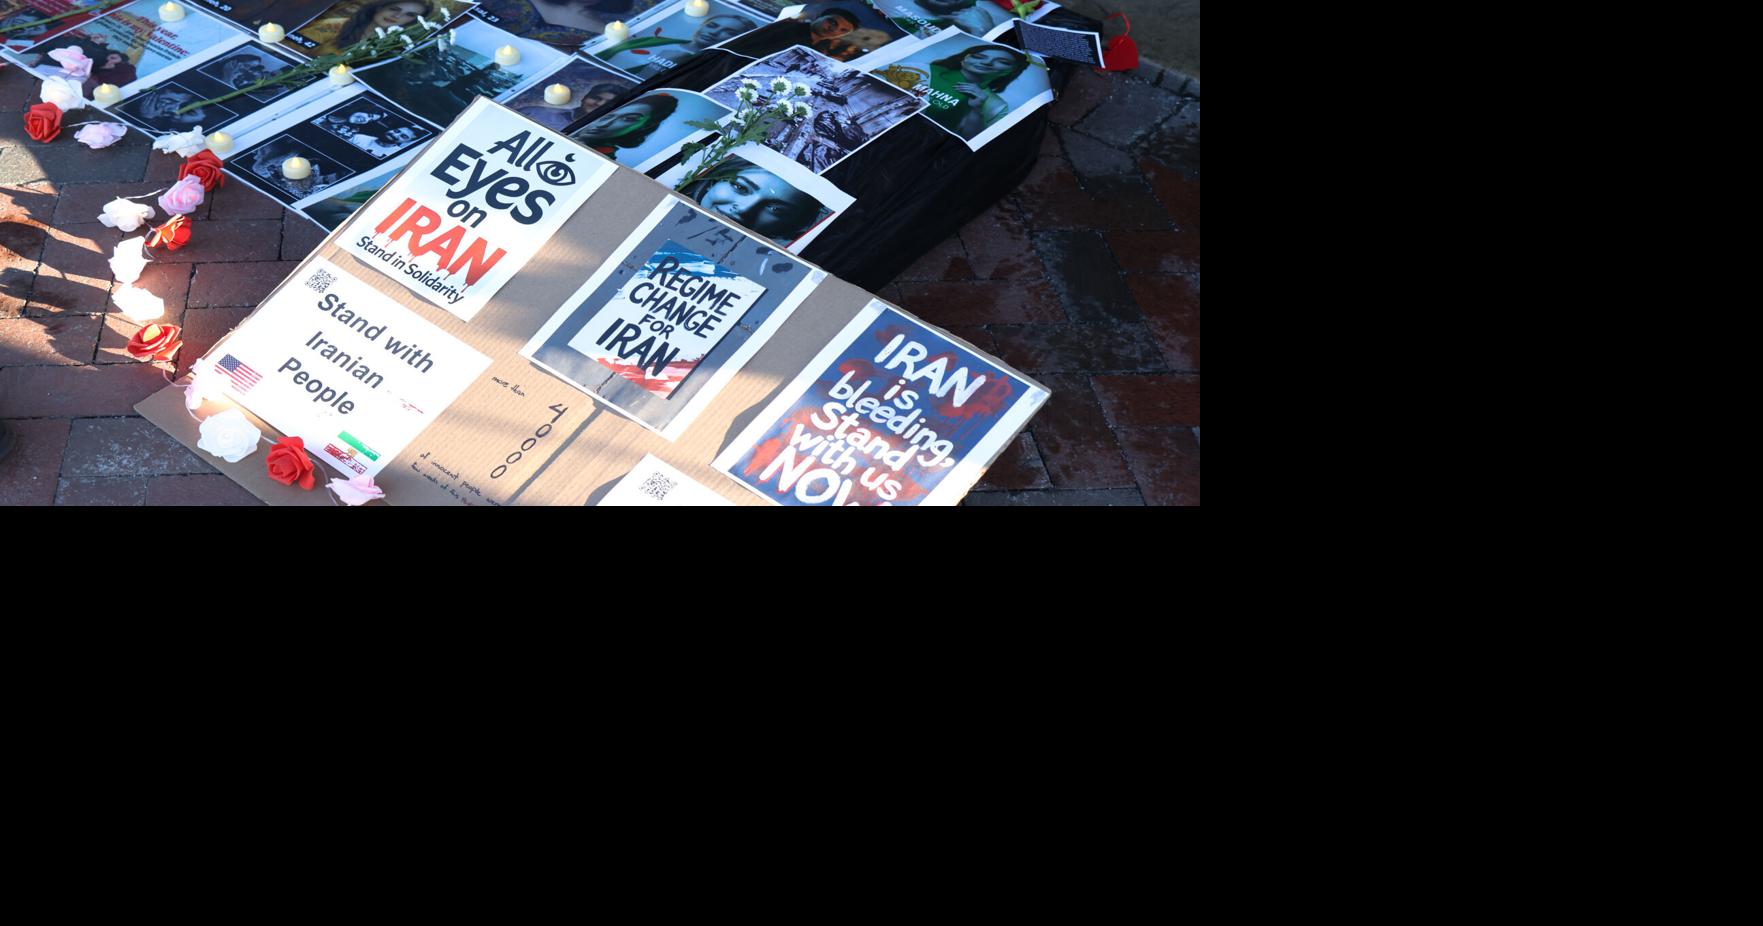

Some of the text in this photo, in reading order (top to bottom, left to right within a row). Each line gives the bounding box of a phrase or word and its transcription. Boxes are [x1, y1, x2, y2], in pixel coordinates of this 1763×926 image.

[648, 54, 678, 69] HADI
[912, 83, 960, 106] MAHNA
[486, 129, 555, 172] All
[430, 142, 556, 225] Eyes
[373, 197, 508, 288] IRAN
[446, 199, 488, 229] on
[356, 235, 465, 305] Stand in Solidarity
[648, 256, 742, 317] REGIME
[317, 293, 434, 374] Stand with
[629, 282, 722, 339] CHANGE
[638, 313, 675, 340] FOR
[305, 331, 384, 389] Iranian
[595, 317, 681, 377] IRAN
[874, 333, 987, 408] IRAN
[277, 356, 355, 415] People
[884, 379, 920, 410] is
[810, 401, 920, 472] Stand
[828, 370, 956, 468] bleeding,
[431, 459, 460, 481] innocent
[789, 423, 903, 501] with us
